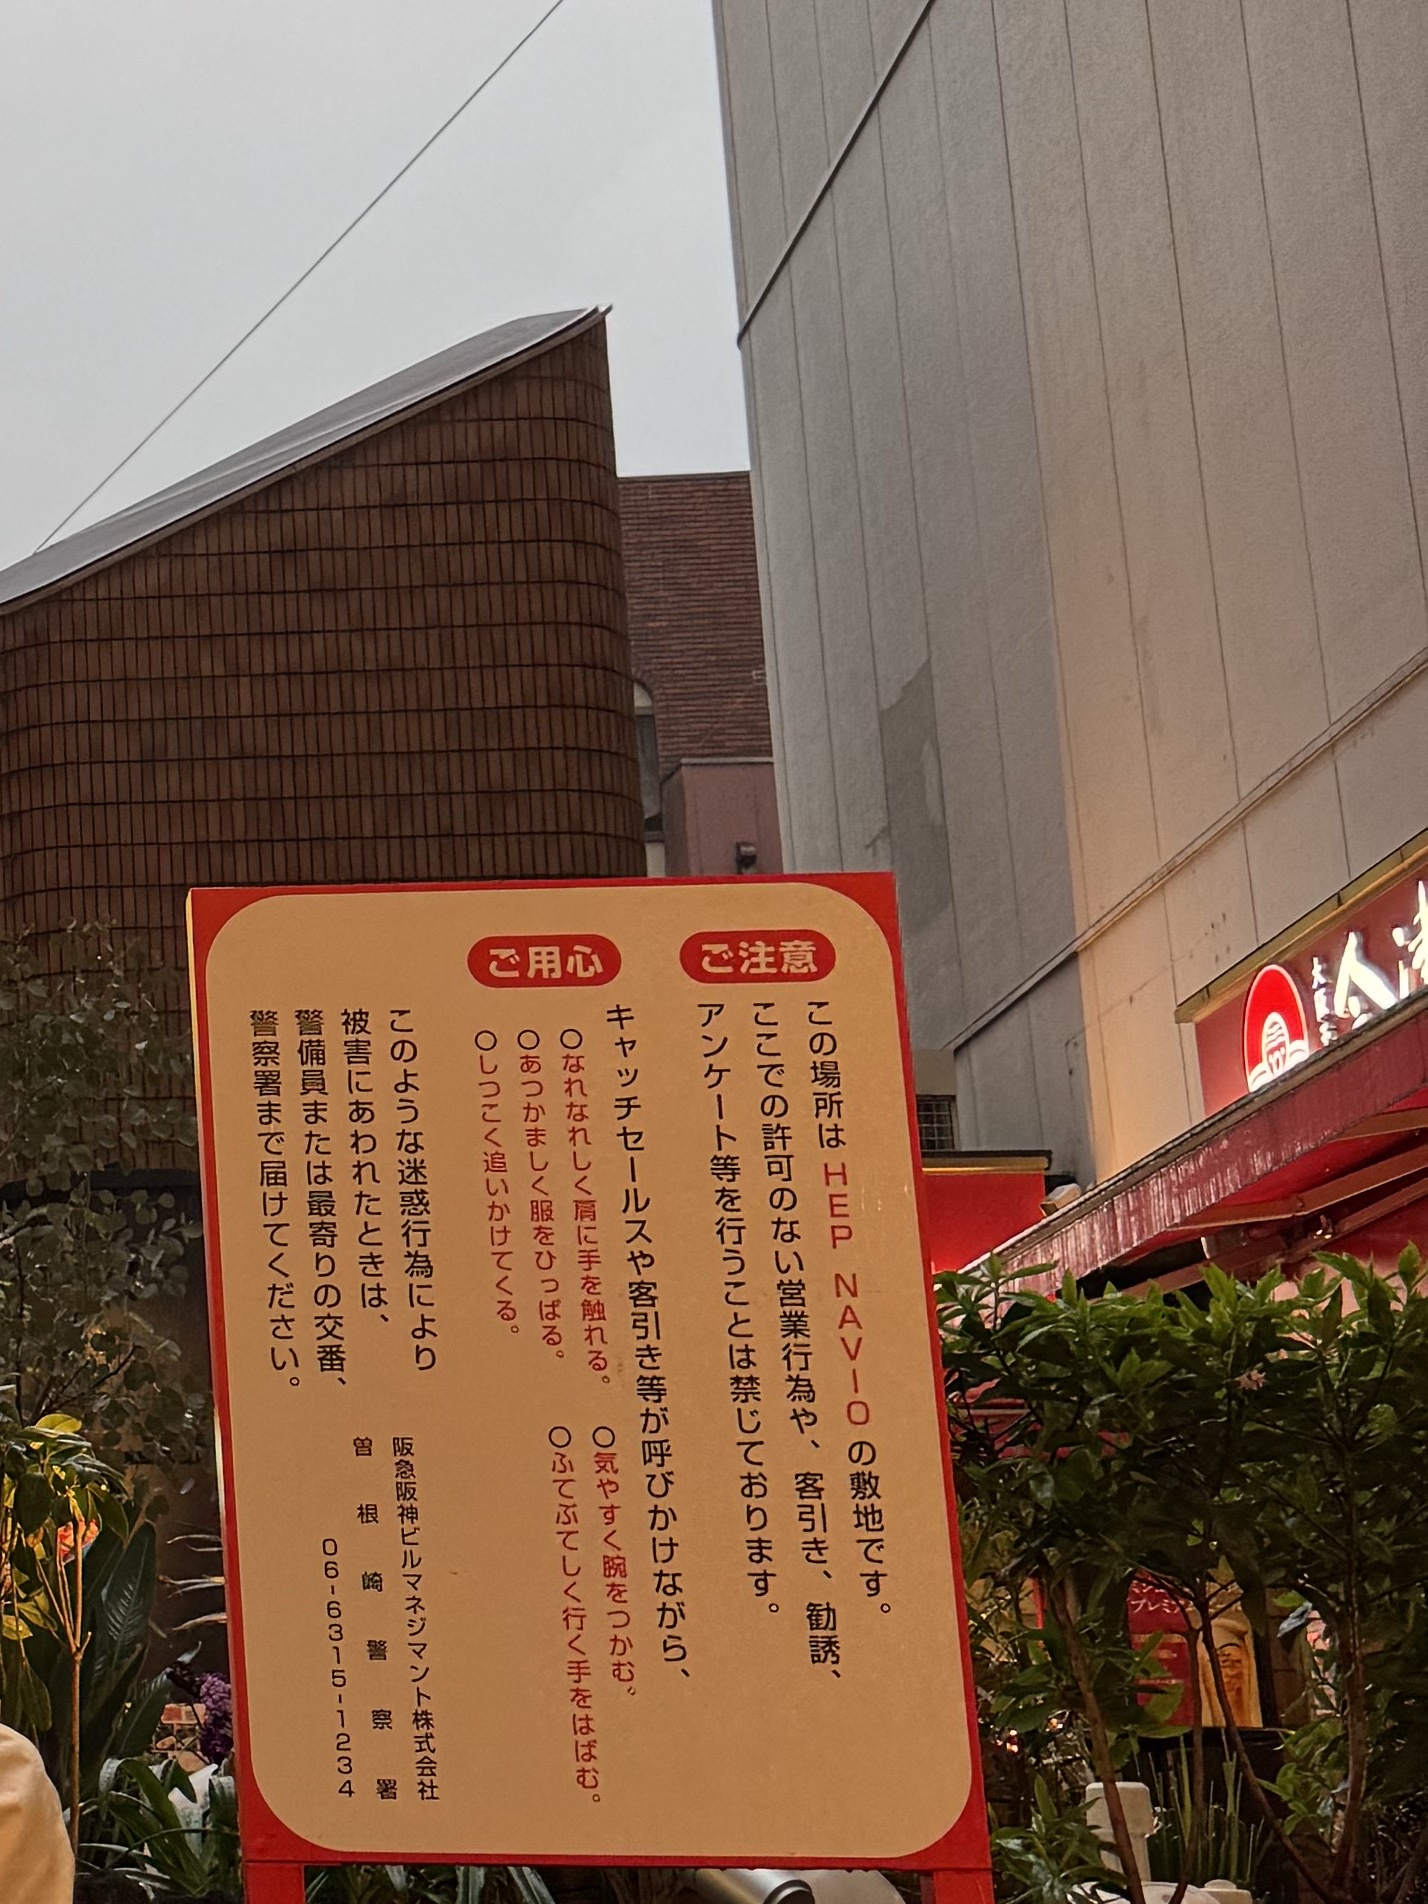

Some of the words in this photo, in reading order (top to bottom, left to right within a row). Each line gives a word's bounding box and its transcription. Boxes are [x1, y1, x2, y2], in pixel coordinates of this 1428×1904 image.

[485, 944, 606, 980] ご用心
[700, 940, 819, 975] ご注意
[249, 1009, 301, 1387] 警察署まで届けてください。
[294, 1009, 347, 1386] 警備員または最寄りの交番、
[340, 1008, 390, 1323] 被害にあわれたときは、
[388, 1009, 438, 1371] このような迷惑行為により
[322, 1537, 355, 1798] 06-6315-1234
